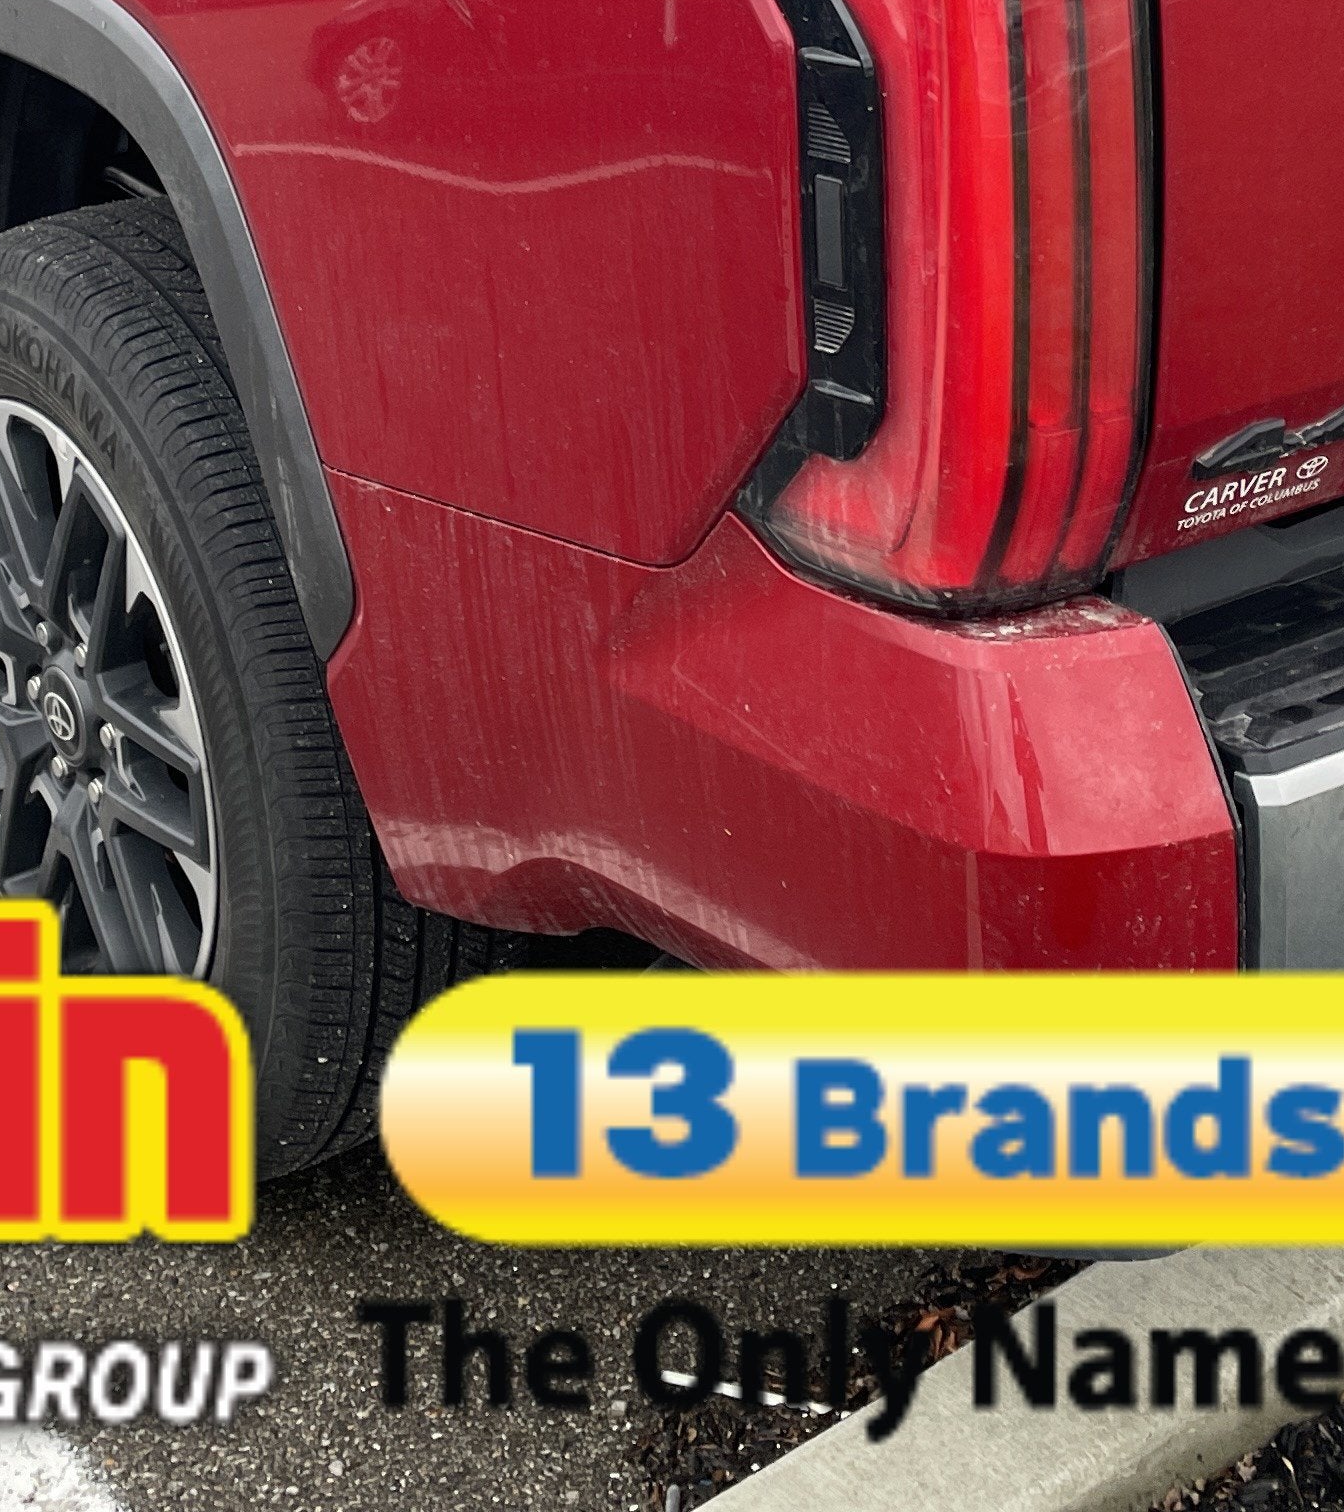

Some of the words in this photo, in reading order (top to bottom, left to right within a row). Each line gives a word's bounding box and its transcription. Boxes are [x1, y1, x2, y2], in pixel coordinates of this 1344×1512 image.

[1177, 507, 1226, 531] TOYOTA
[1229, 500, 1247, 515] OF
[1249, 478, 1321, 509] COLUMBUS
[1184, 467, 1287, 513] CARVER
